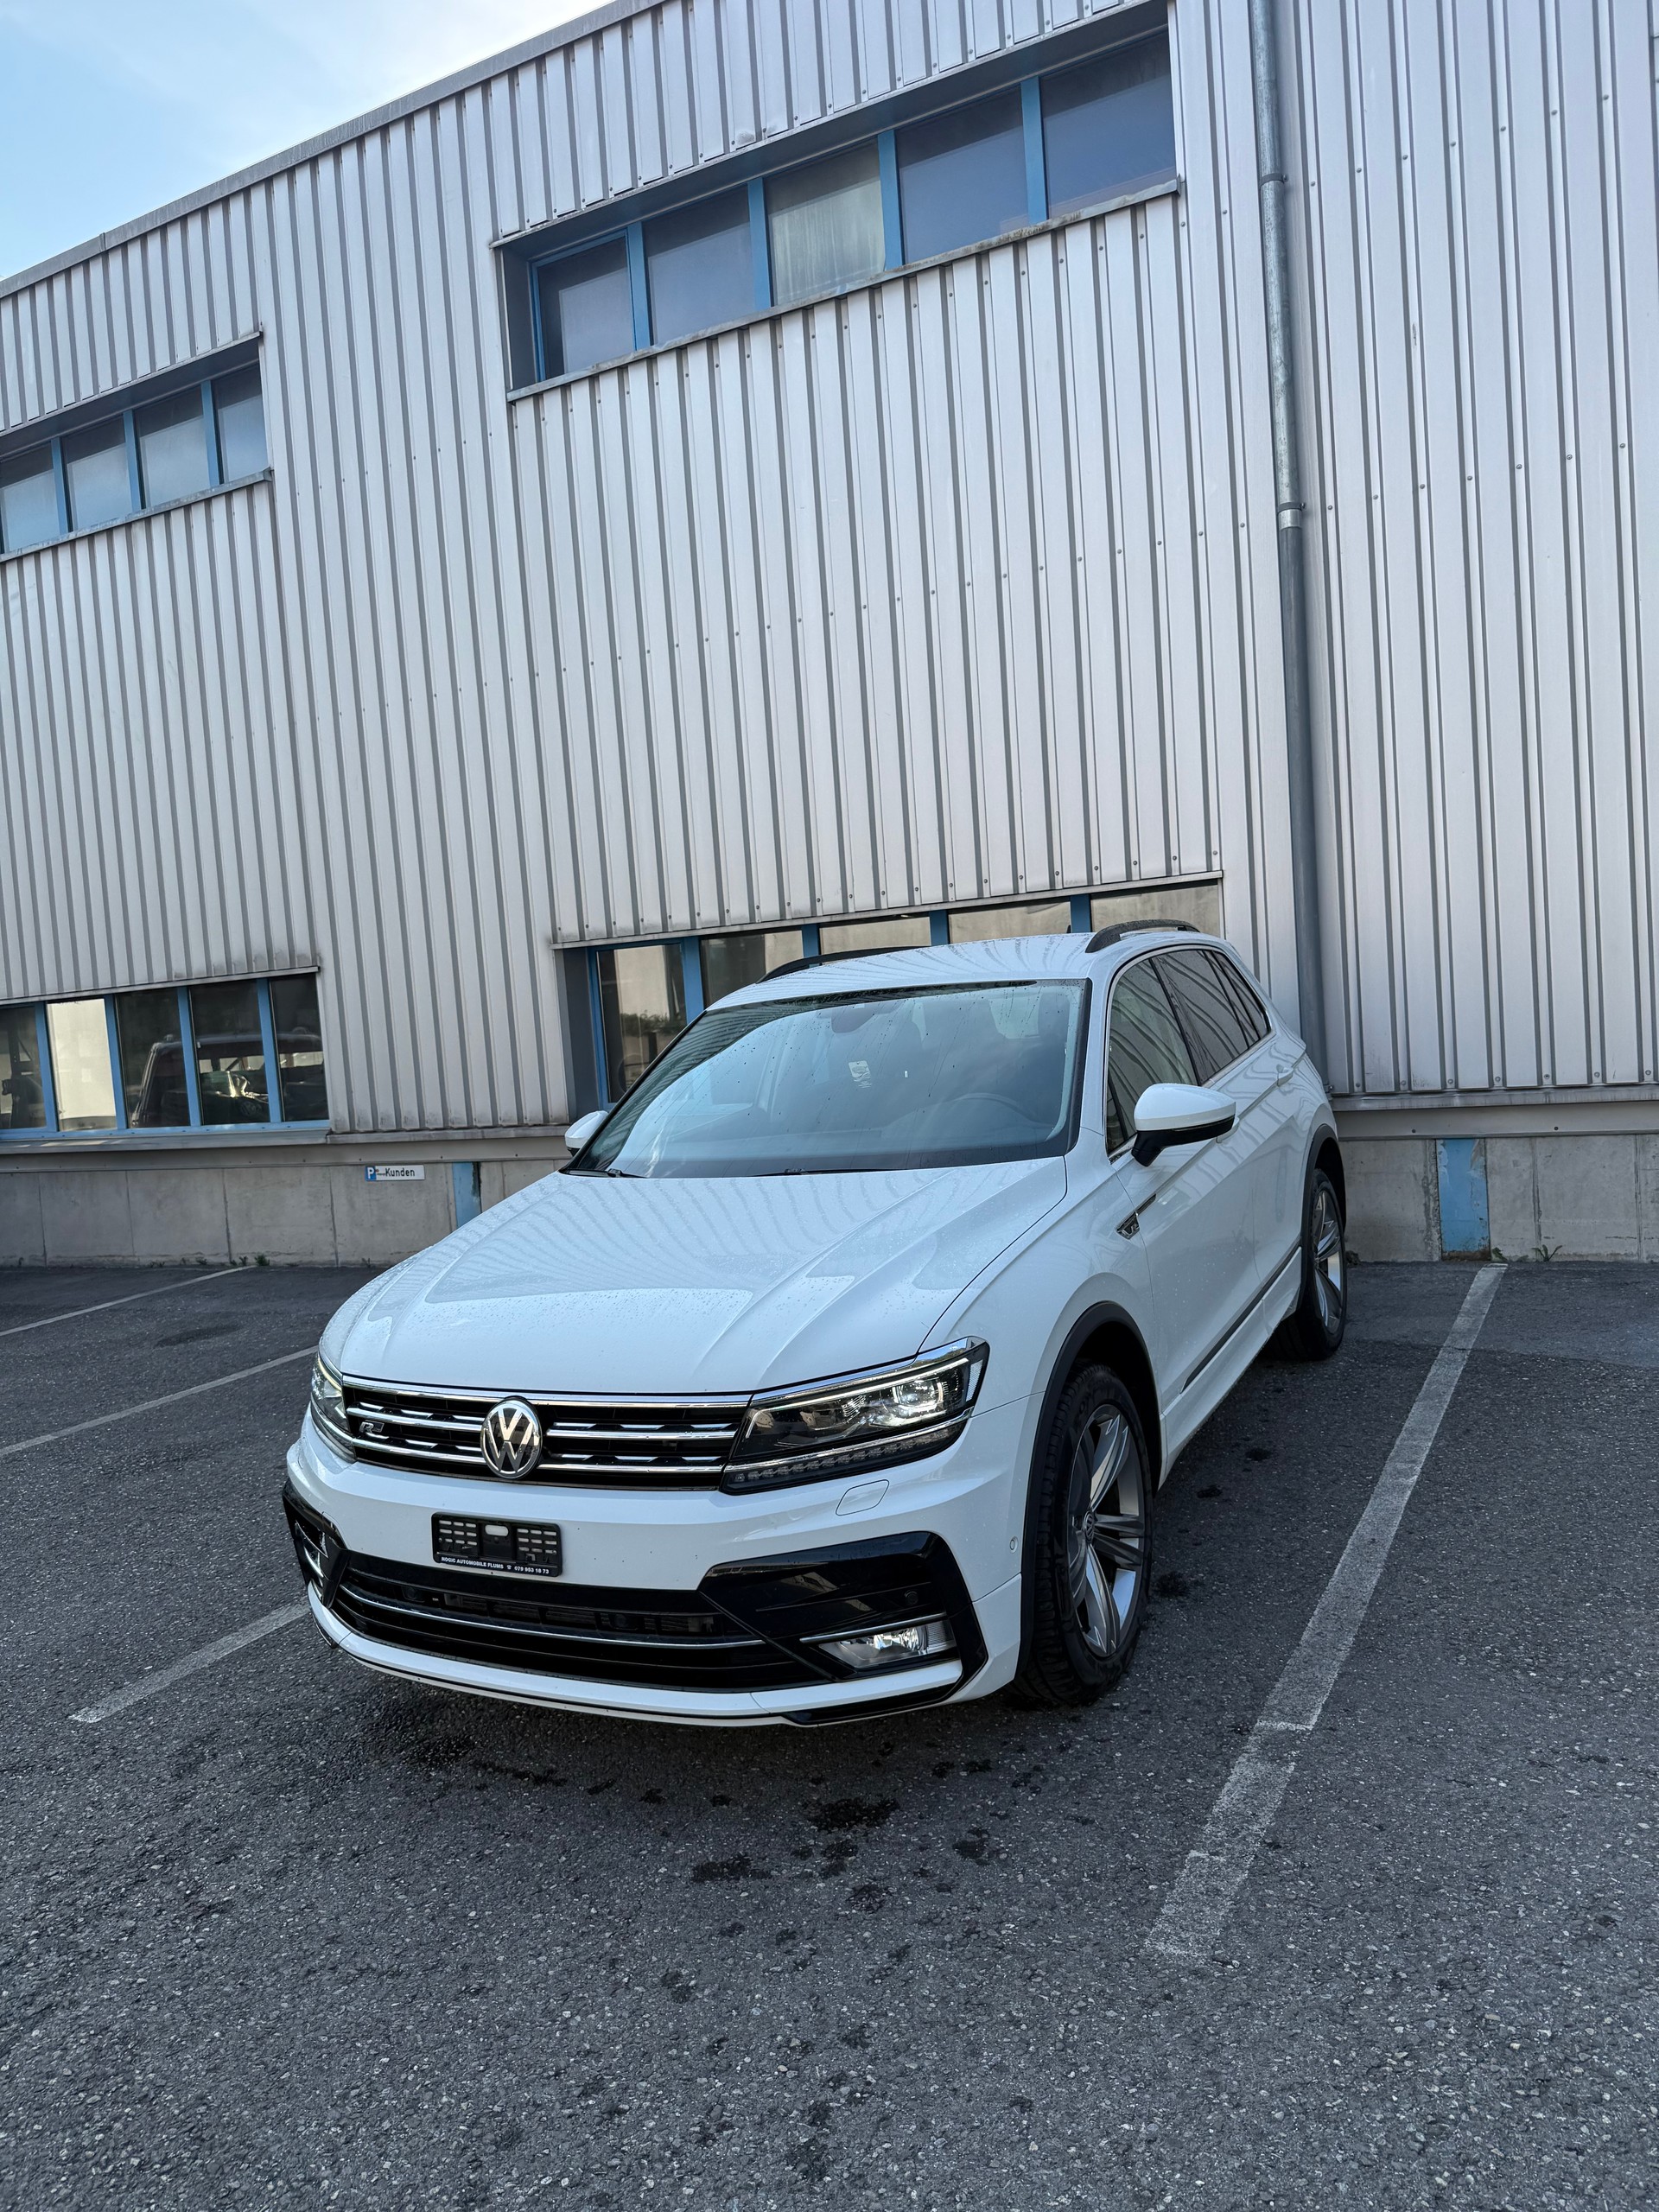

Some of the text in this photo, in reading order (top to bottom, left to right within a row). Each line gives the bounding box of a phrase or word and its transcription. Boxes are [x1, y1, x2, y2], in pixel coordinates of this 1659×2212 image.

[367, 1167, 374, 1179] P
[385, 1168, 415, 1177] Kunden
[482, 1401, 541, 1477] VW
